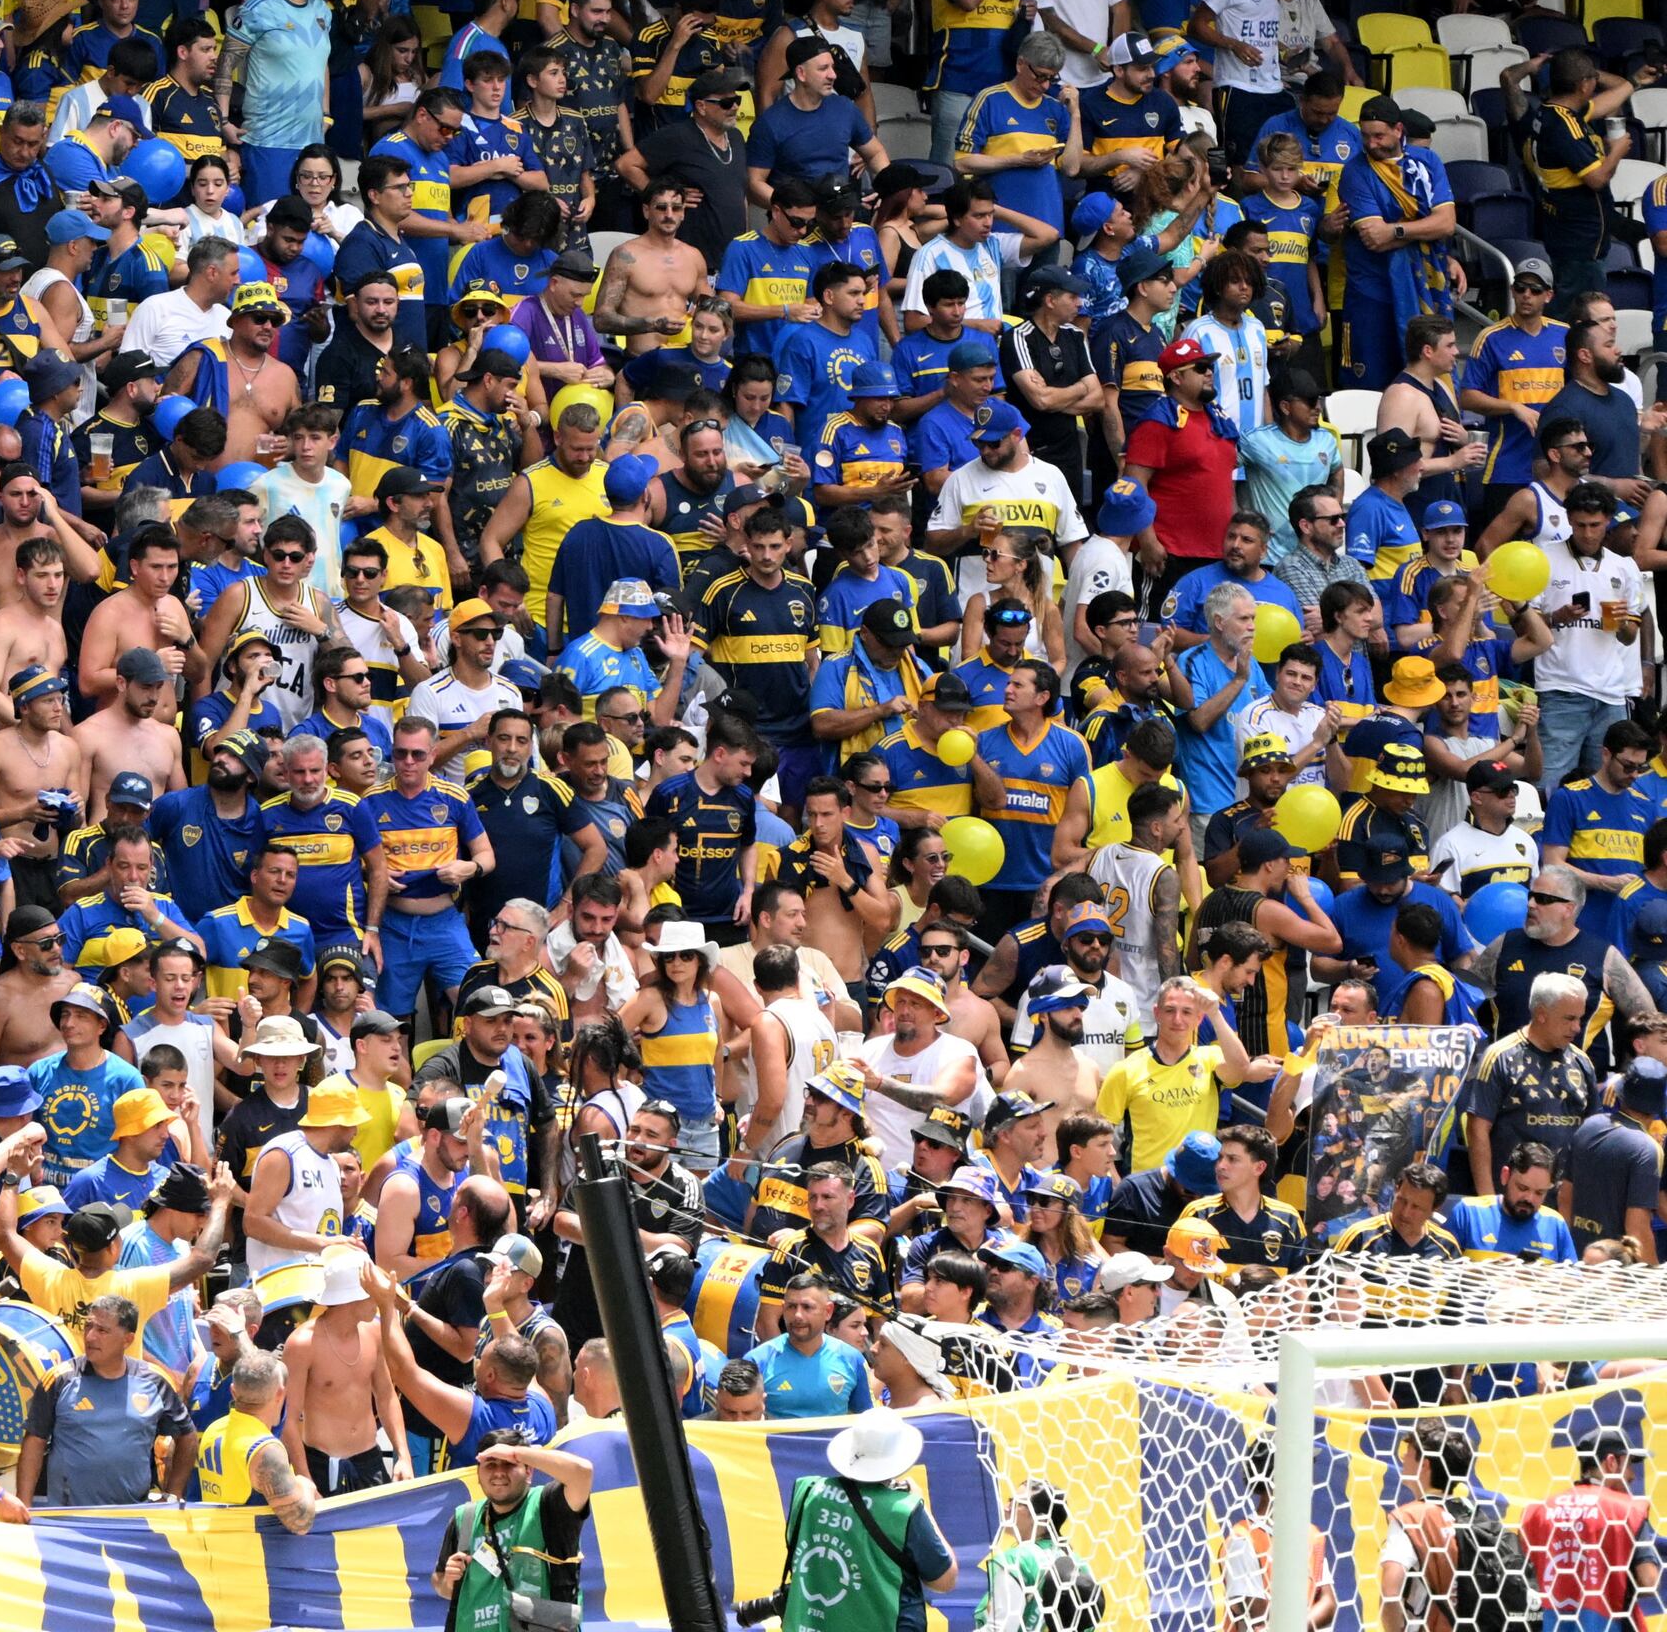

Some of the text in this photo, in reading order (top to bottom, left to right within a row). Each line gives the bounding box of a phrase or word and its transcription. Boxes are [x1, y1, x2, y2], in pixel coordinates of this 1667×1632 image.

[1240, 19, 1255, 38] EL
[578, 106, 619, 119] betss
[1236, 377, 1253, 401] 10
[475, 475, 515, 493] betss
[749, 641, 800, 655] betsso
[1005, 792, 1049, 811] malat
[382, 840, 450, 858] betsson
[1594, 832, 1639, 851] QATAR
[677, 846, 736, 860] betsson
[1320, 1026, 1465, 1056] ROMANCE
[1388, 1052, 1465, 1071] ETERNO
[53, 1084, 88, 1099] WORLD
[1150, 1087, 1201, 1106] QATAR
[1525, 1111, 1583, 1128] betsson
[818, 1507, 853, 1532] 330
[809, 1532, 849, 1549] WORLD
[847, 1555, 864, 1592] CUP
